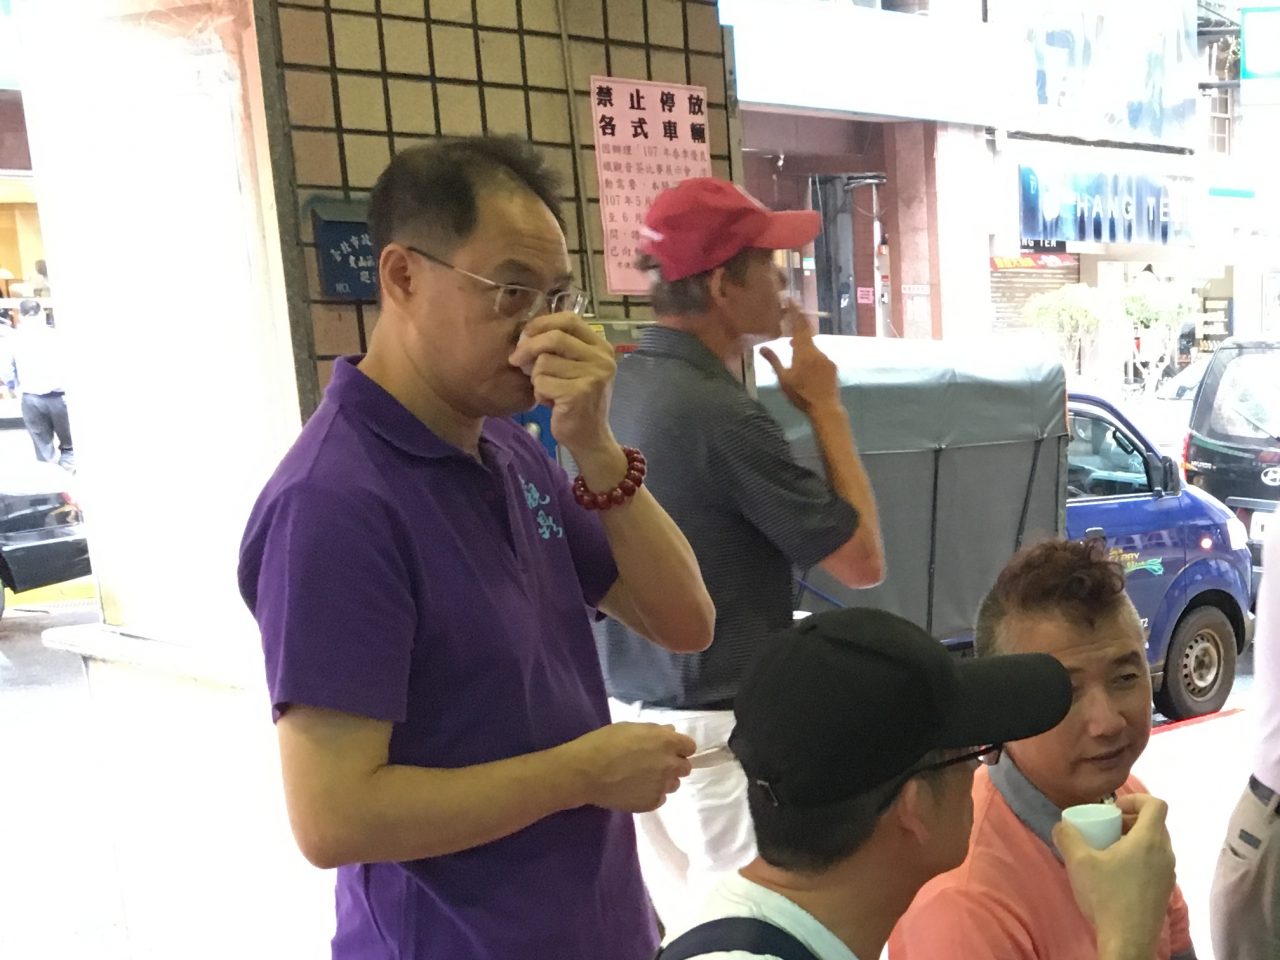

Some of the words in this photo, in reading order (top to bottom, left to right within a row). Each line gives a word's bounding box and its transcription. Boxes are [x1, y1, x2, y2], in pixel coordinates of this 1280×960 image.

[596, 85, 704, 116] 禁止停放
[599, 114, 706, 143] 各式車輛
[1077, 196, 1133, 220] HANG
